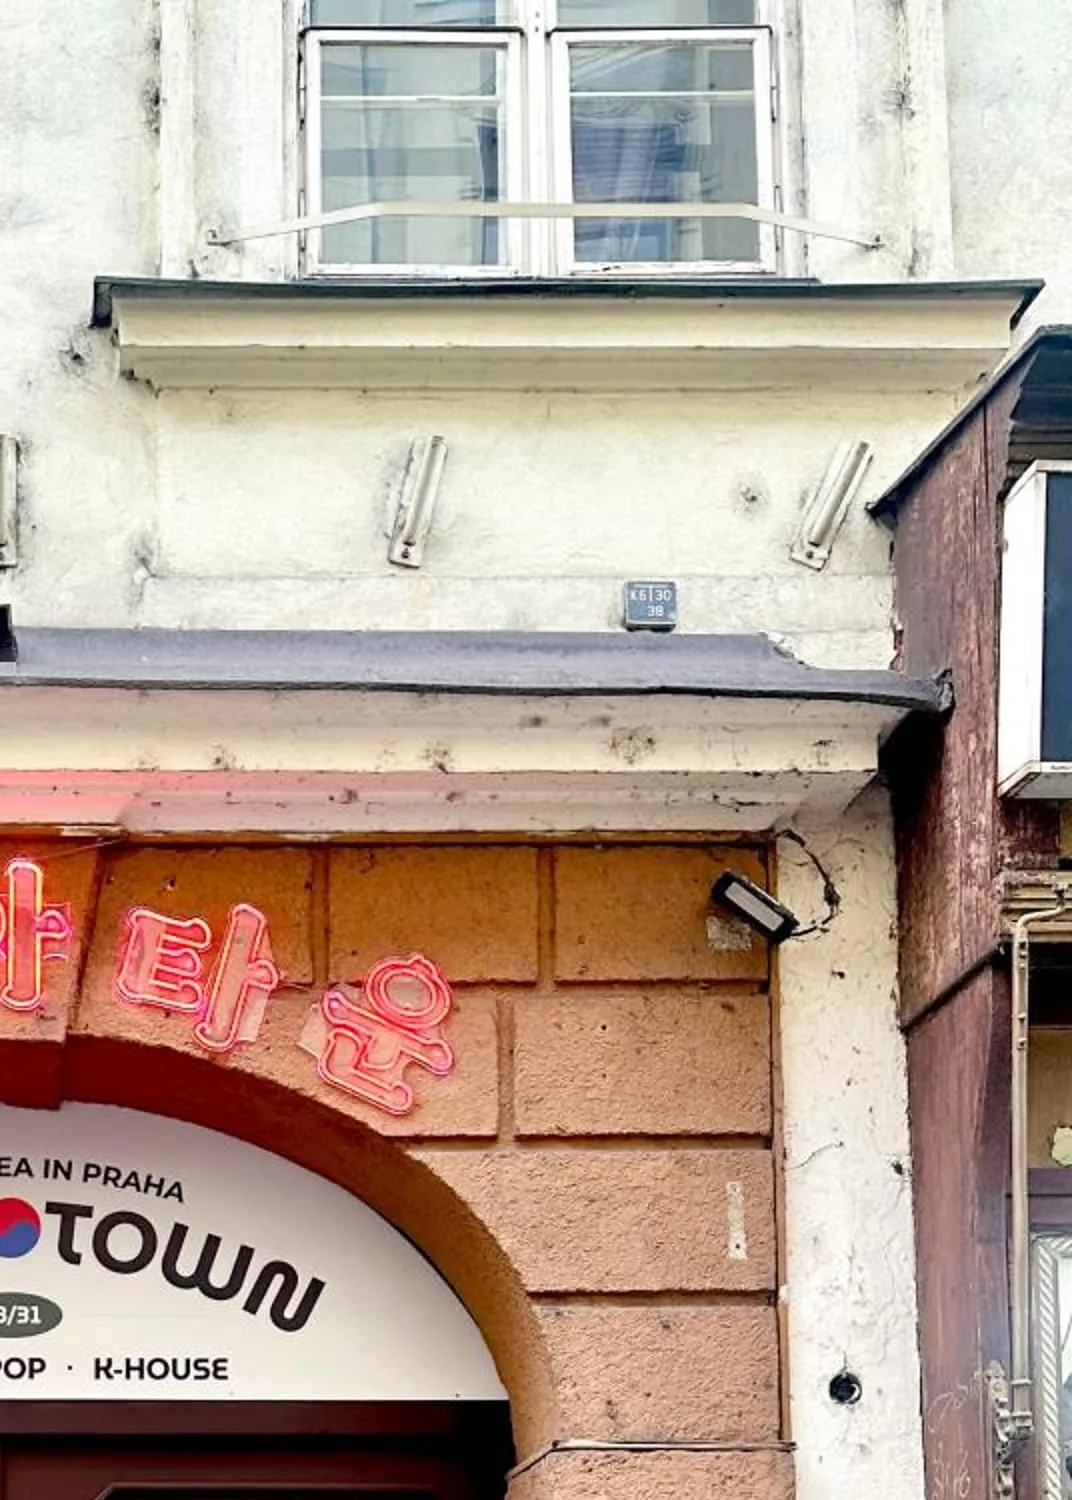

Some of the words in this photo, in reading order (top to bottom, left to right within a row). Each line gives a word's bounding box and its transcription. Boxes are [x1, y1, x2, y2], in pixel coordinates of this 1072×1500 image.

[43, 1158, 73, 1181] IN
[82, 1163, 184, 1204] PRAHA
[45, 1200, 326, 1333] TOWN
[95, 1358, 229, 1381] K-HOUSE
